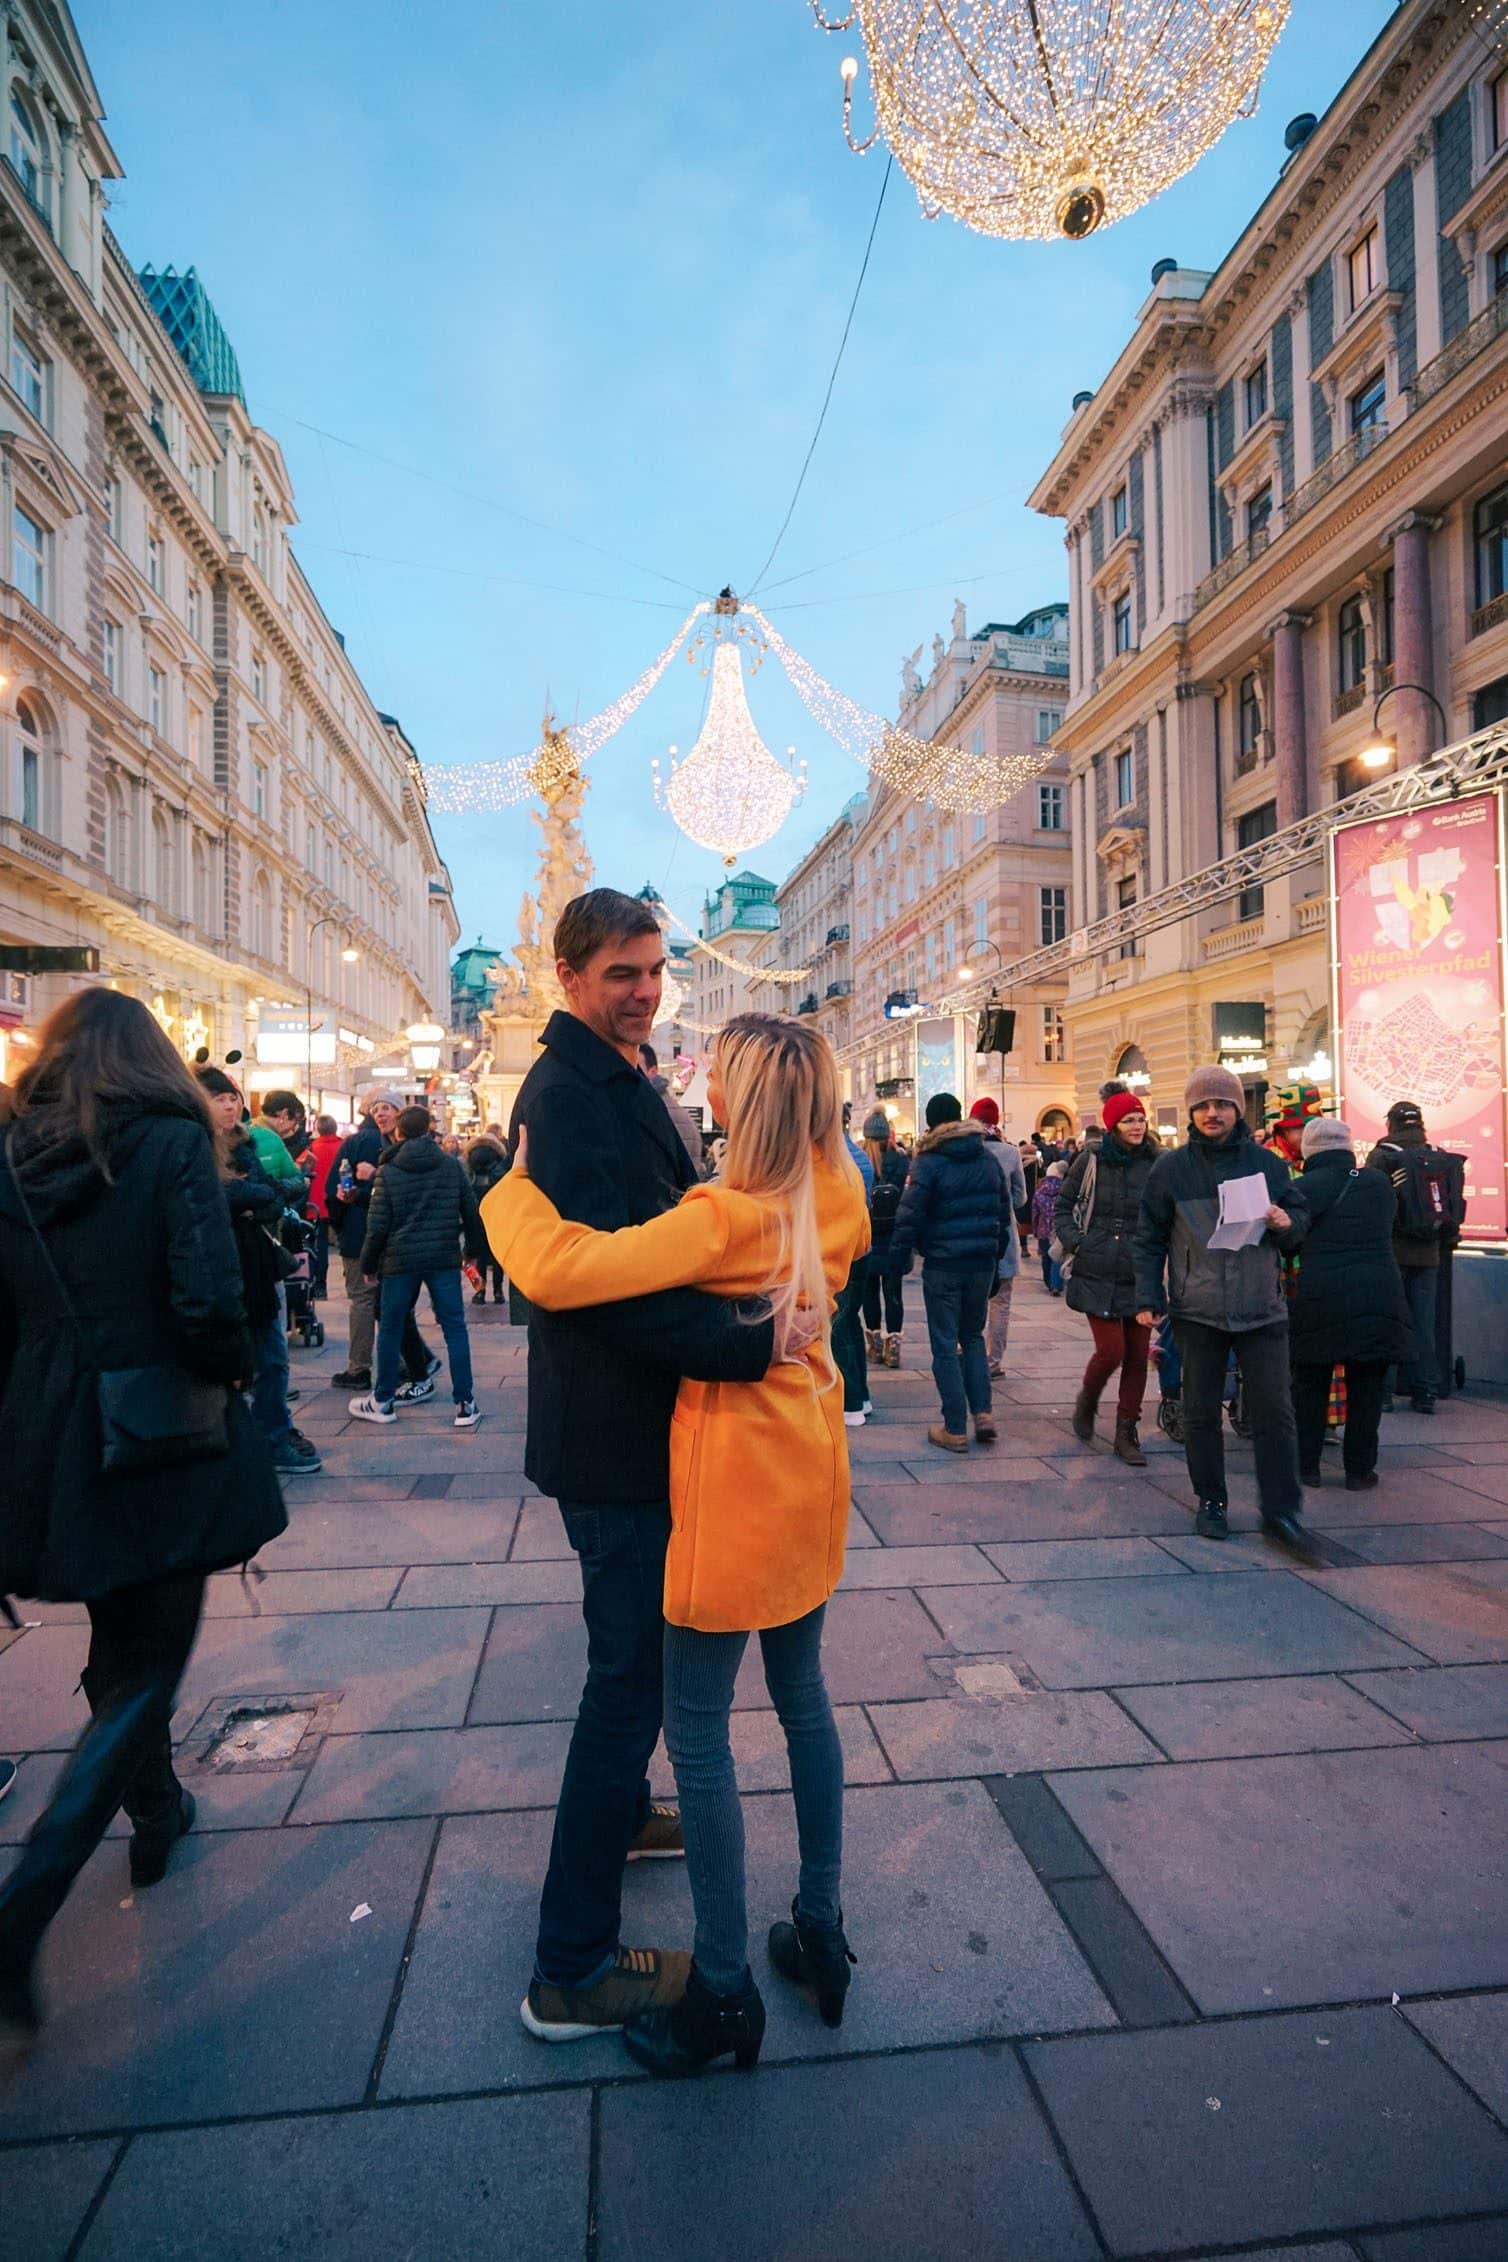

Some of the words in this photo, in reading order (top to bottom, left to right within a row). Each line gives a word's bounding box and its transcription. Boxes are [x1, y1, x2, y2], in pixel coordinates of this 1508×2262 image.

[1348, 948, 1423, 969] Wiener
[1350, 950, 1491, 986] Silvesterpfad
[1353, 1139, 1376, 1152] Sta
